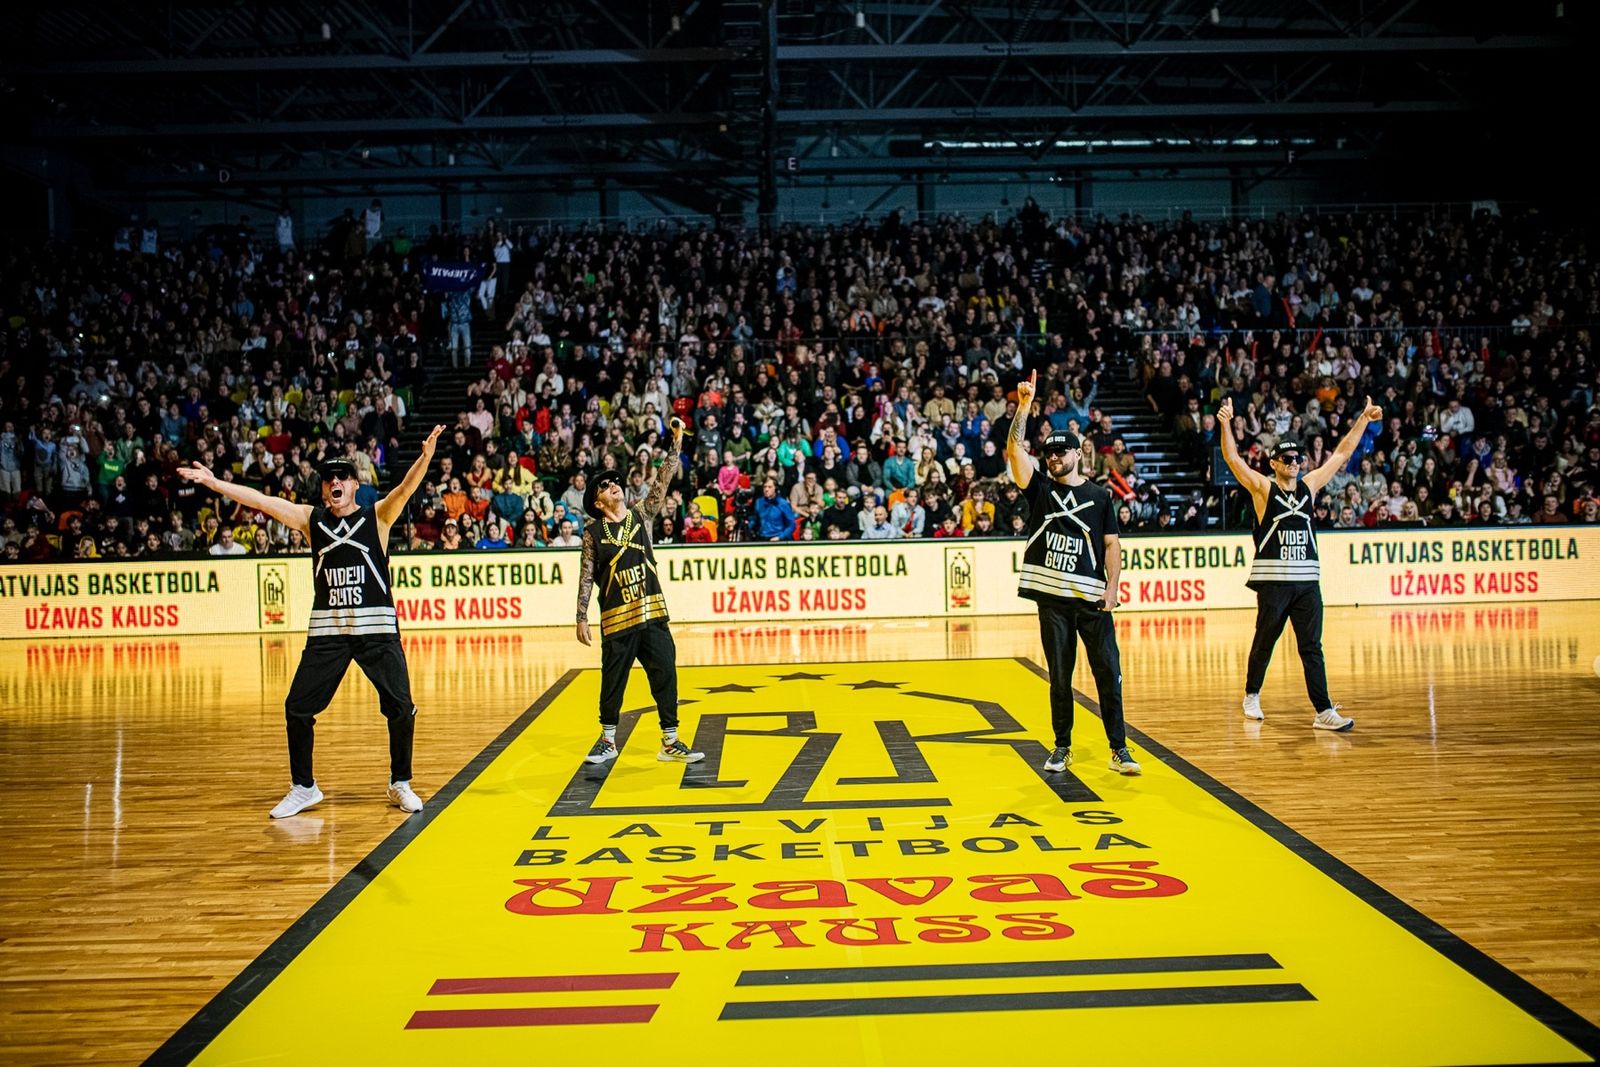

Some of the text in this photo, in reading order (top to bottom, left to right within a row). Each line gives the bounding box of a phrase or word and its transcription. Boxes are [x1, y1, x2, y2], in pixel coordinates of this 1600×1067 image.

[788, 157, 796, 170] E
[1288, 150, 1295, 164] F
[219, 169, 230, 183] D
[1120, 546, 1246, 570] BASKETBOLA
[1349, 538, 1579, 565] LATVIJAS BASKETBOLA
[431, 563, 563, 587] BASKETBOLA
[669, 555, 908, 581] LATVIJAS BASKETBOLA
[0, 570, 219, 597] ATVIJAS BASKETBOLA
[1140, 579, 1206, 602] KAUSS
[1390, 570, 1538, 596] UŽAVAS KAUSS
[396, 597, 522, 621] AVAS KAUSS
[712, 587, 866, 613] UŽAVAS KAUSS
[25, 603, 179, 630] UŽAVAS KAUSS
[532, 809, 1124, 841] LATVIJAS
[513, 833, 1152, 867] BASKETBOLA
[630, 912, 1075, 953] KAUSS
